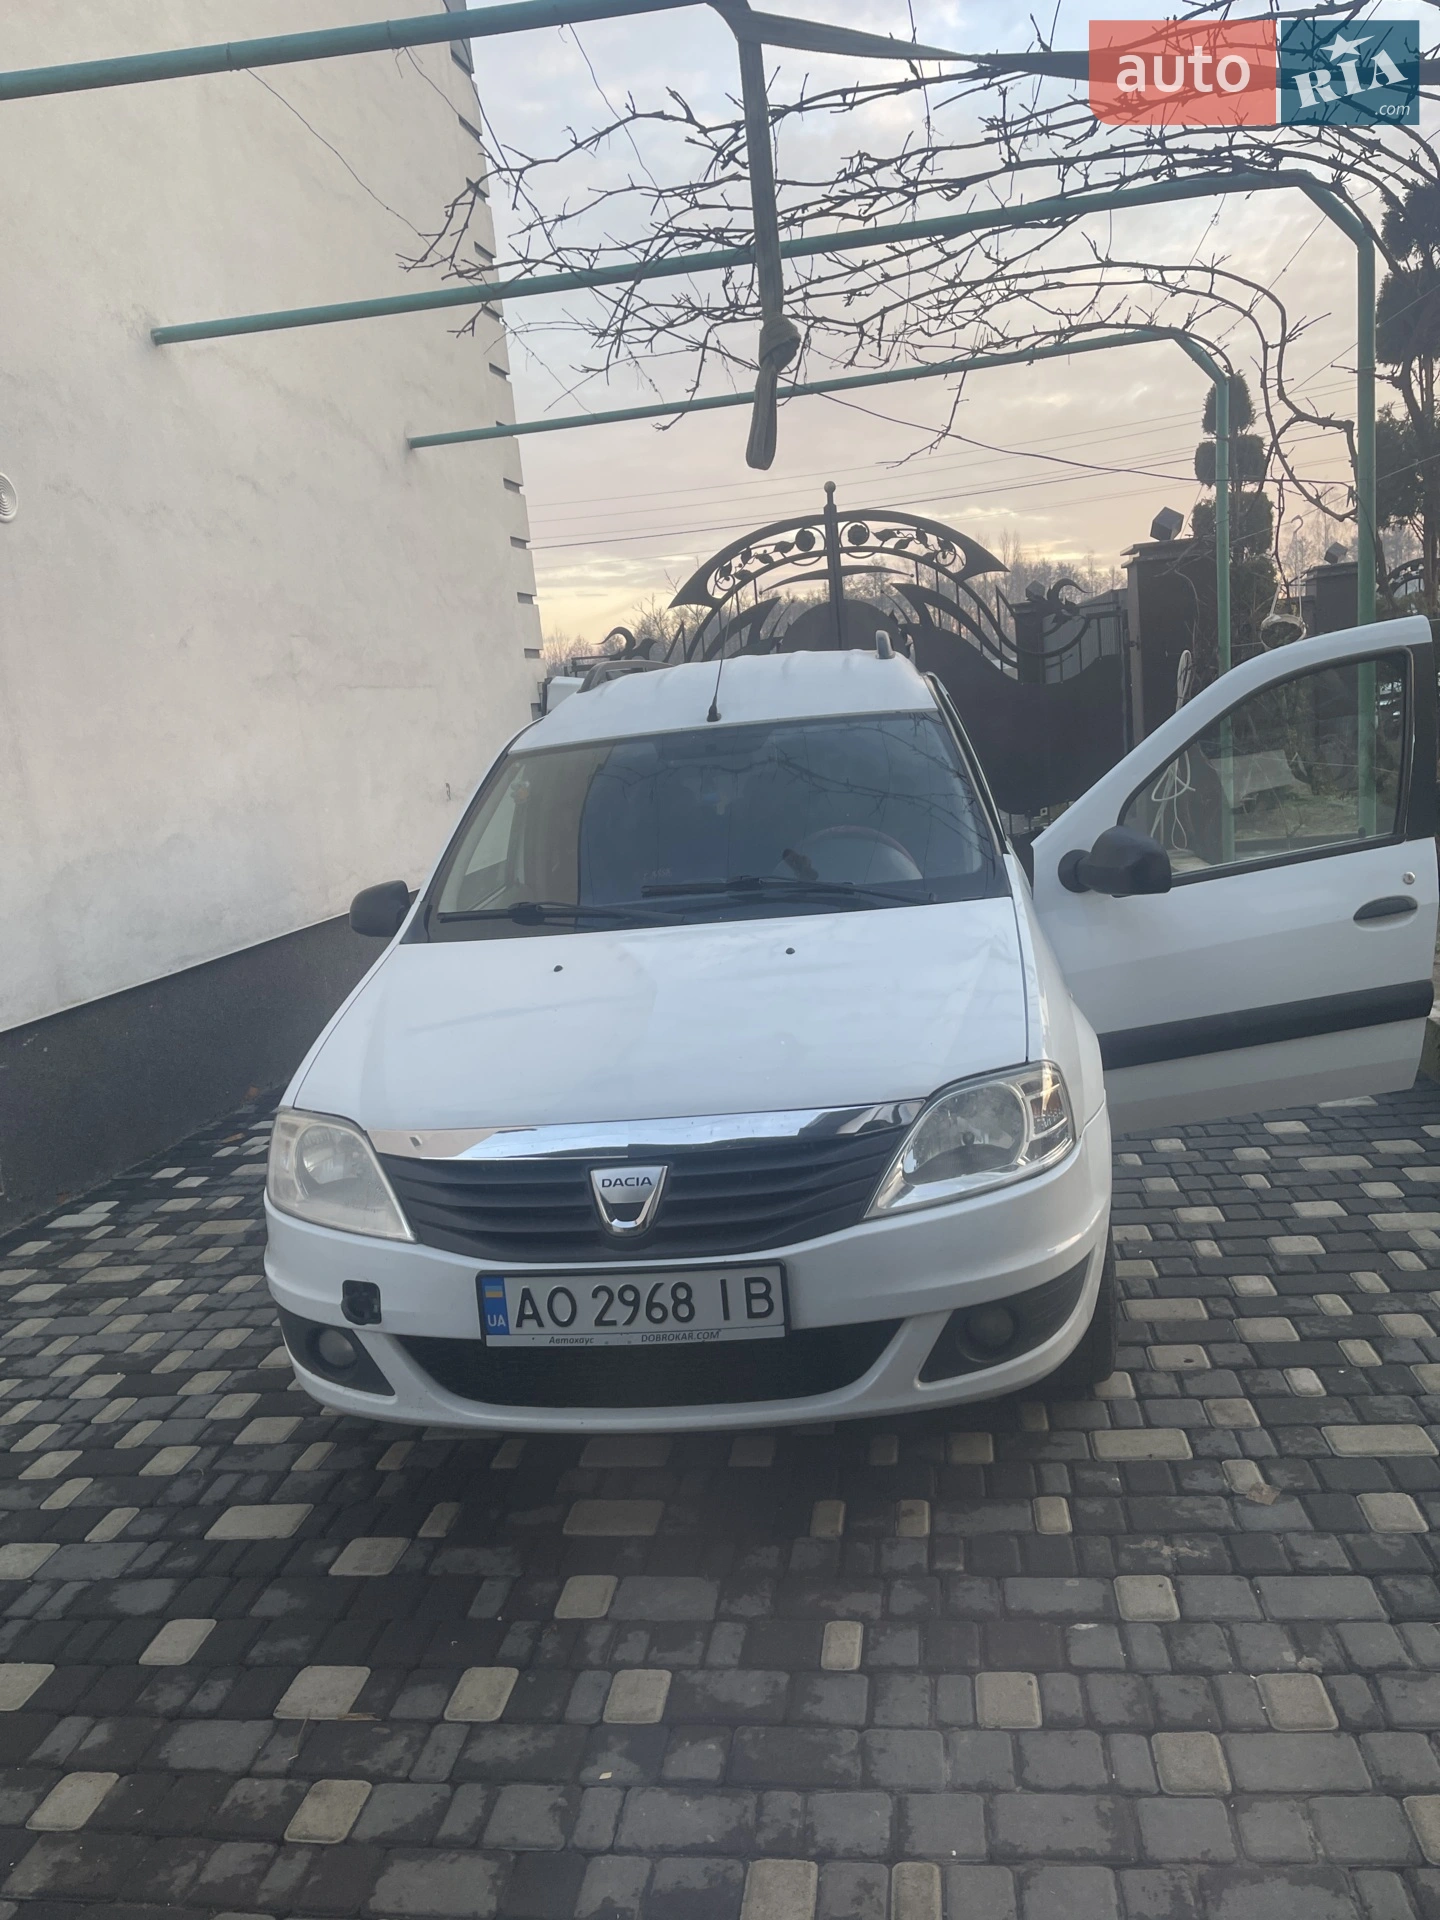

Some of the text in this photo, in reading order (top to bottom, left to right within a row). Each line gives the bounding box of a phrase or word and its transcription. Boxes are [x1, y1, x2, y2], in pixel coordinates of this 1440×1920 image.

[601, 1176, 652, 1188] DACIA
[515, 1276, 775, 1328] AO 2968 IB
[487, 1314, 507, 1328] UA
[641, 1329, 720, 1343] DOBROKAR.COM
